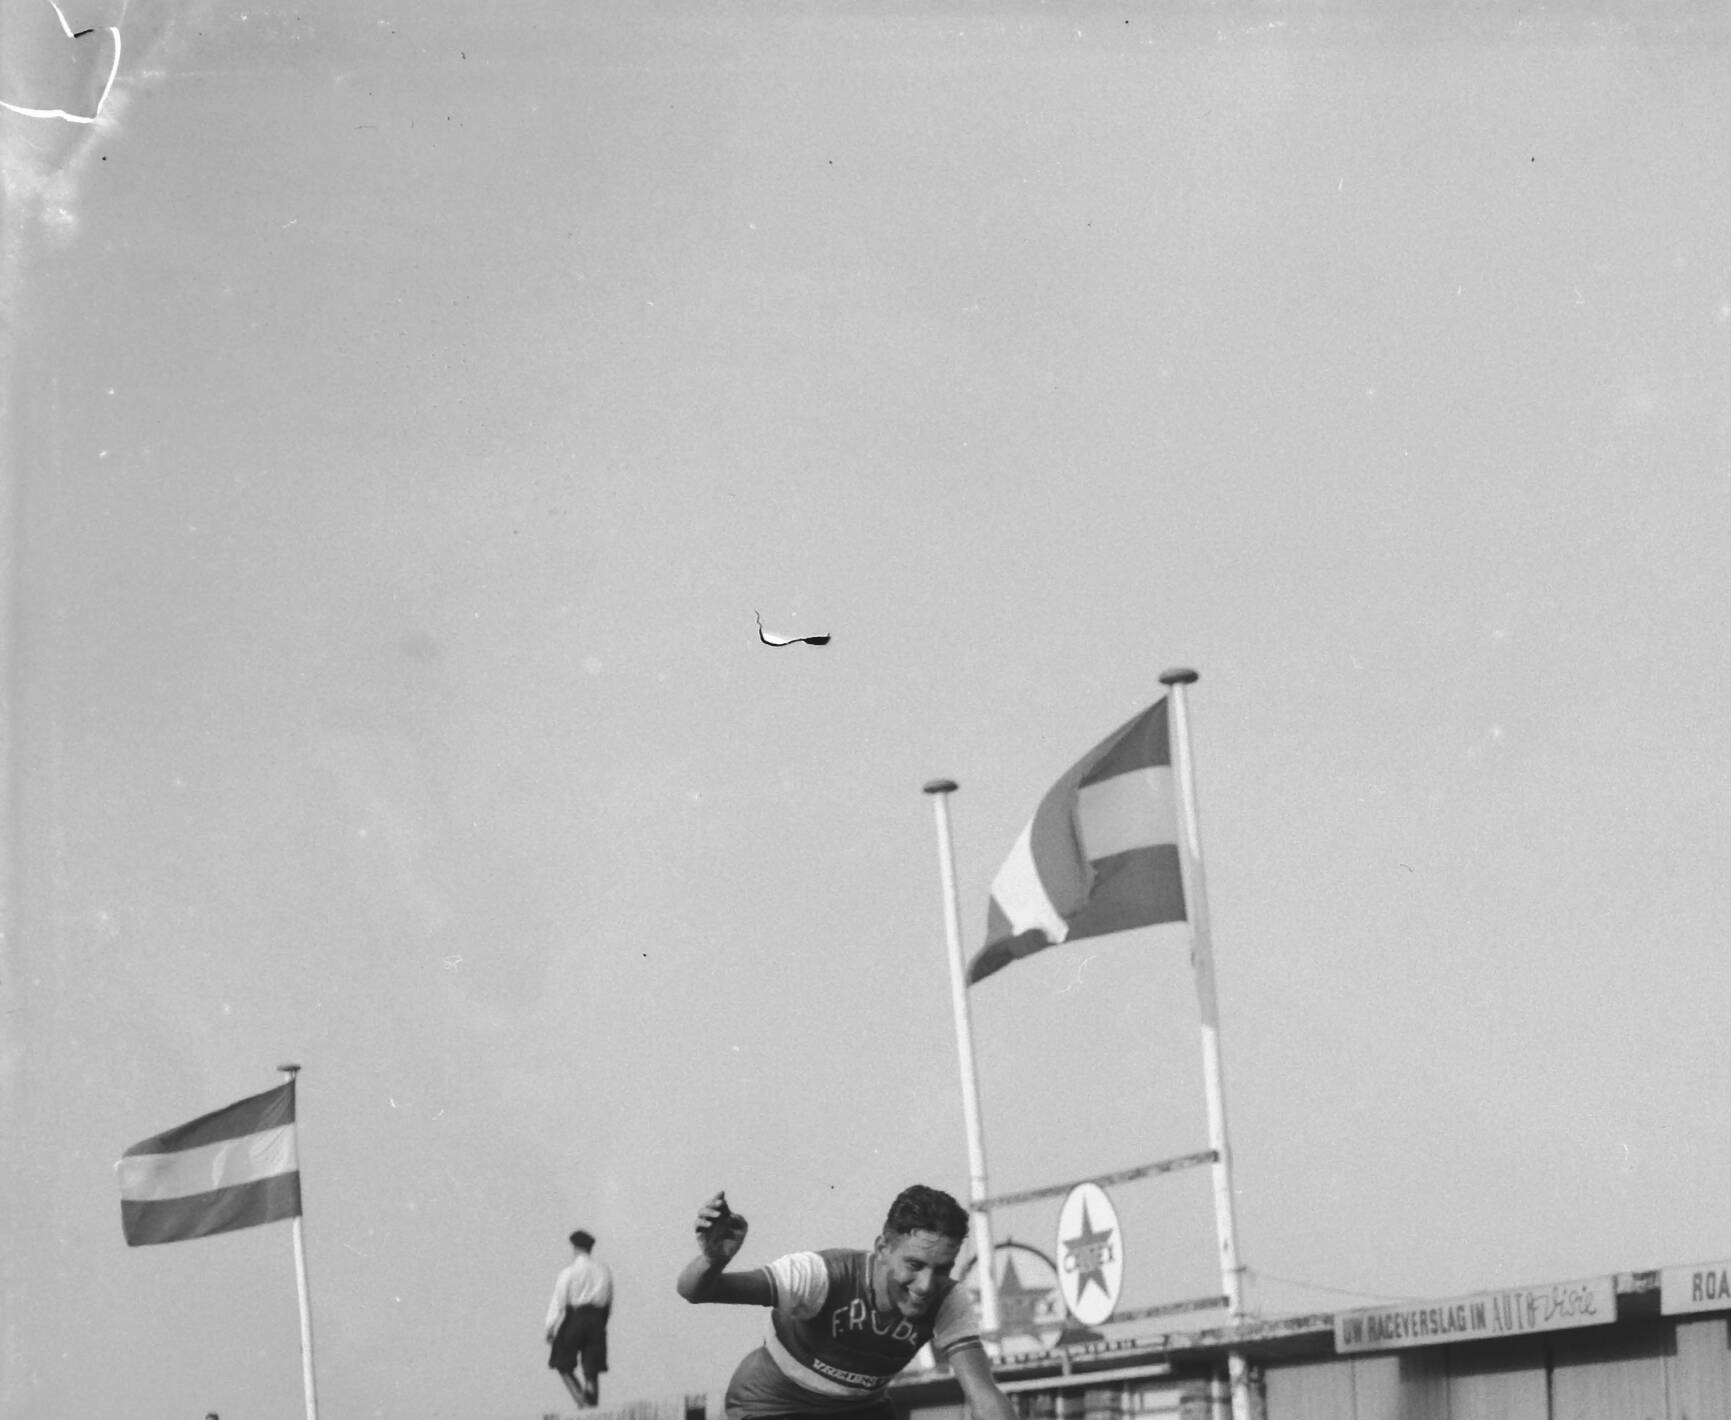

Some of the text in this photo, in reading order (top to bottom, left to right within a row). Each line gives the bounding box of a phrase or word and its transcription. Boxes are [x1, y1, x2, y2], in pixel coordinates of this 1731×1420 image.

[1343, 1318, 1364, 1345] UW
[1367, 1304, 1467, 1341] RACEVERSLAG
[1470, 1300, 1487, 1331] IN
